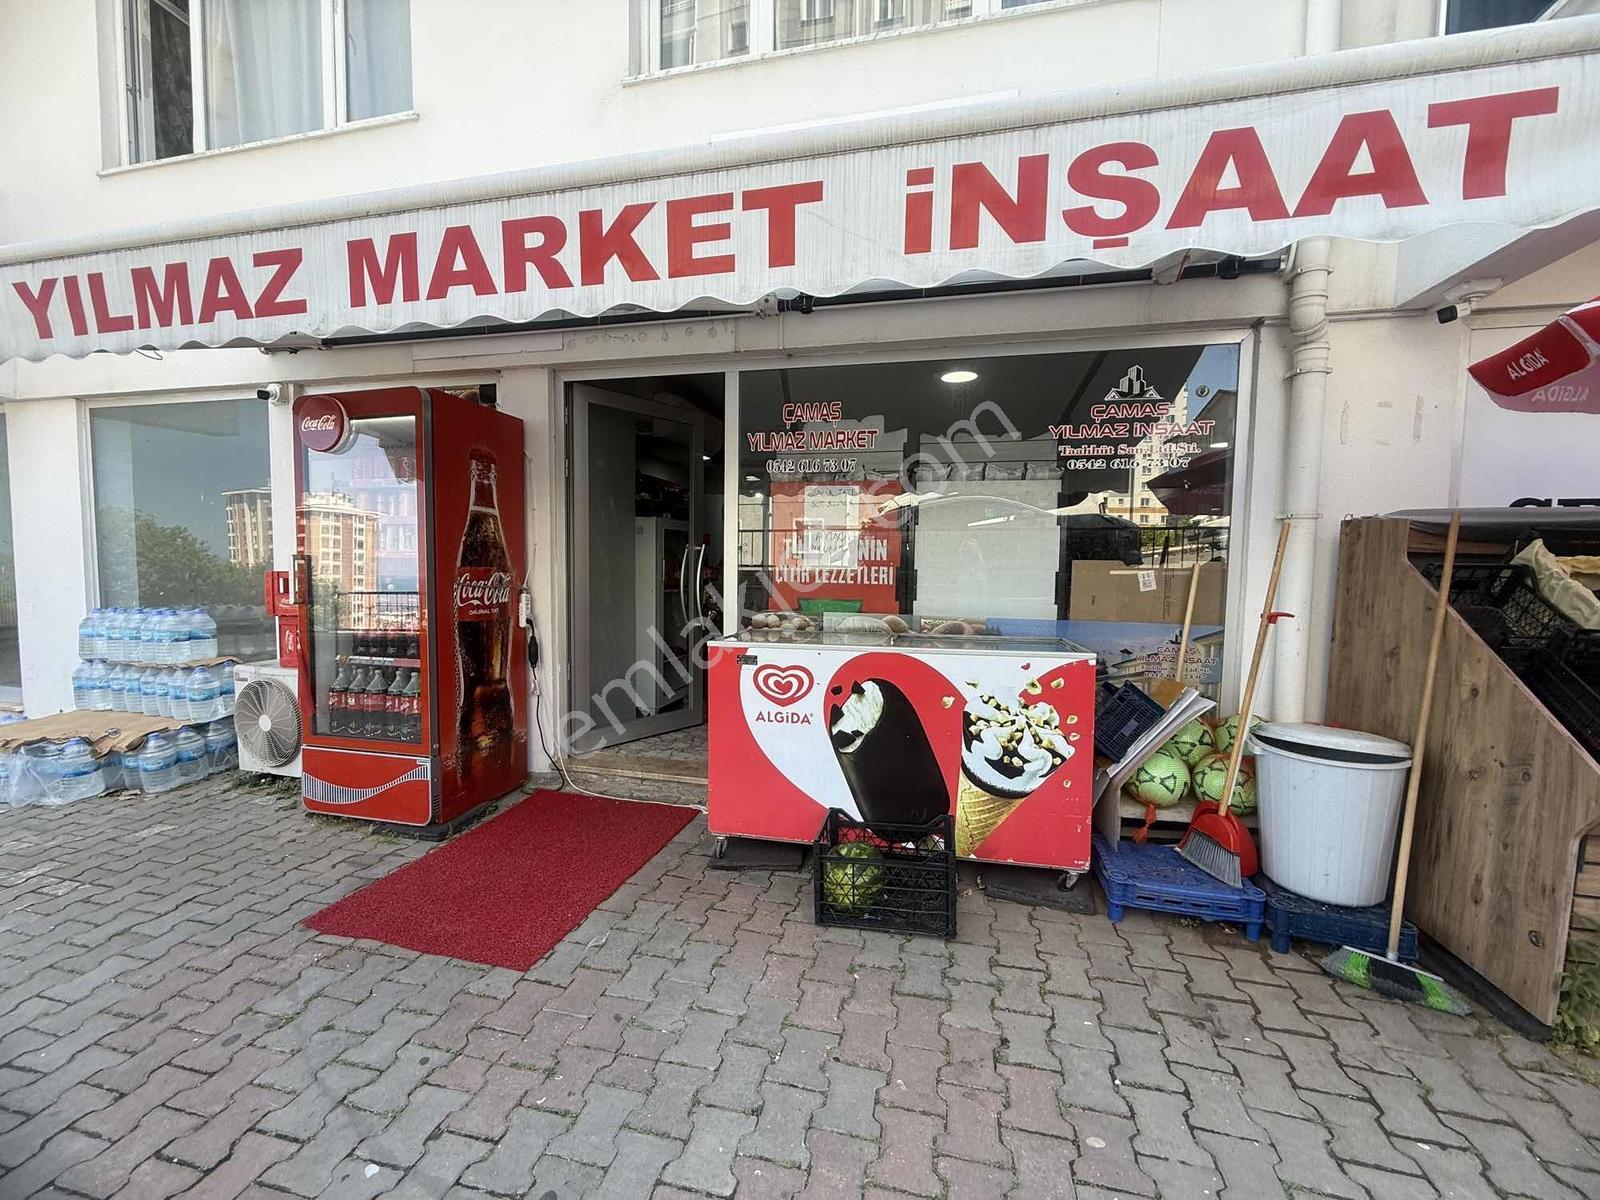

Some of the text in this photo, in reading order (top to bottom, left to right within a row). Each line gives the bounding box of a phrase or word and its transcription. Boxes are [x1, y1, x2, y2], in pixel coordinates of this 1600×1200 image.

[12, 247, 307, 339] YILMAZ
[347, 181, 823, 307] MARKET
[782, 402, 842, 429] ÇAMAŞ
[1090, 402, 1173, 423] ÇAMAŞ
[747, 429, 879, 452] YILMAZ MARKET
[1048, 423, 1130, 439] YILMAZ
[766, 458, 857, 473] 0542 616 73 07
[1066, 458, 1107, 470] 0542
[1109, 458, 1140, 469] 616
[1169, 456, 1192, 469] 07
